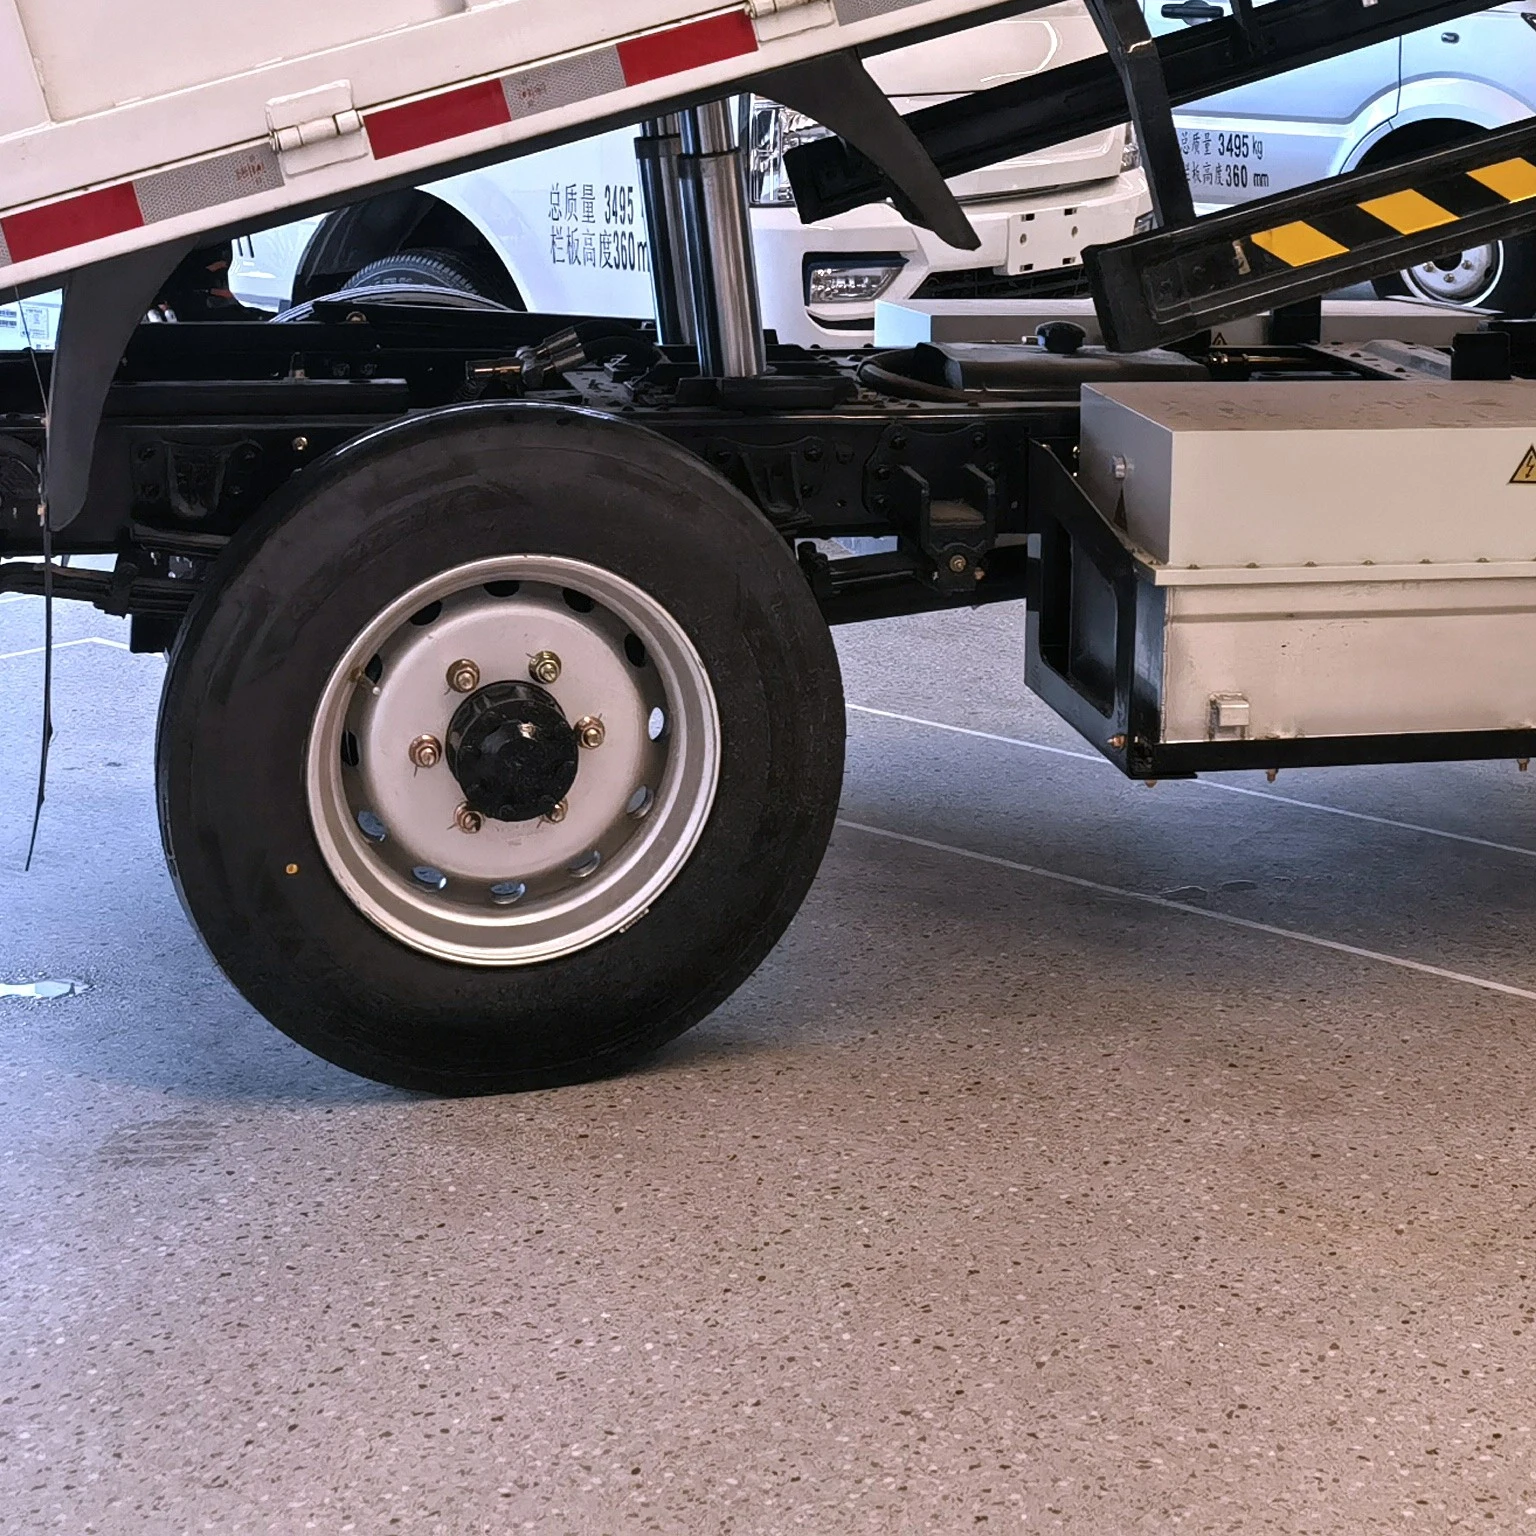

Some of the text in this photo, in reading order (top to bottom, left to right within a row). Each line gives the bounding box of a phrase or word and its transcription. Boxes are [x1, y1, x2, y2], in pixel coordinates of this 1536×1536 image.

[1181, 131, 1263, 159] 总质量 3495 kg
[549, 183, 596, 224] 总质量
[604, 184, 634, 224] 3495
